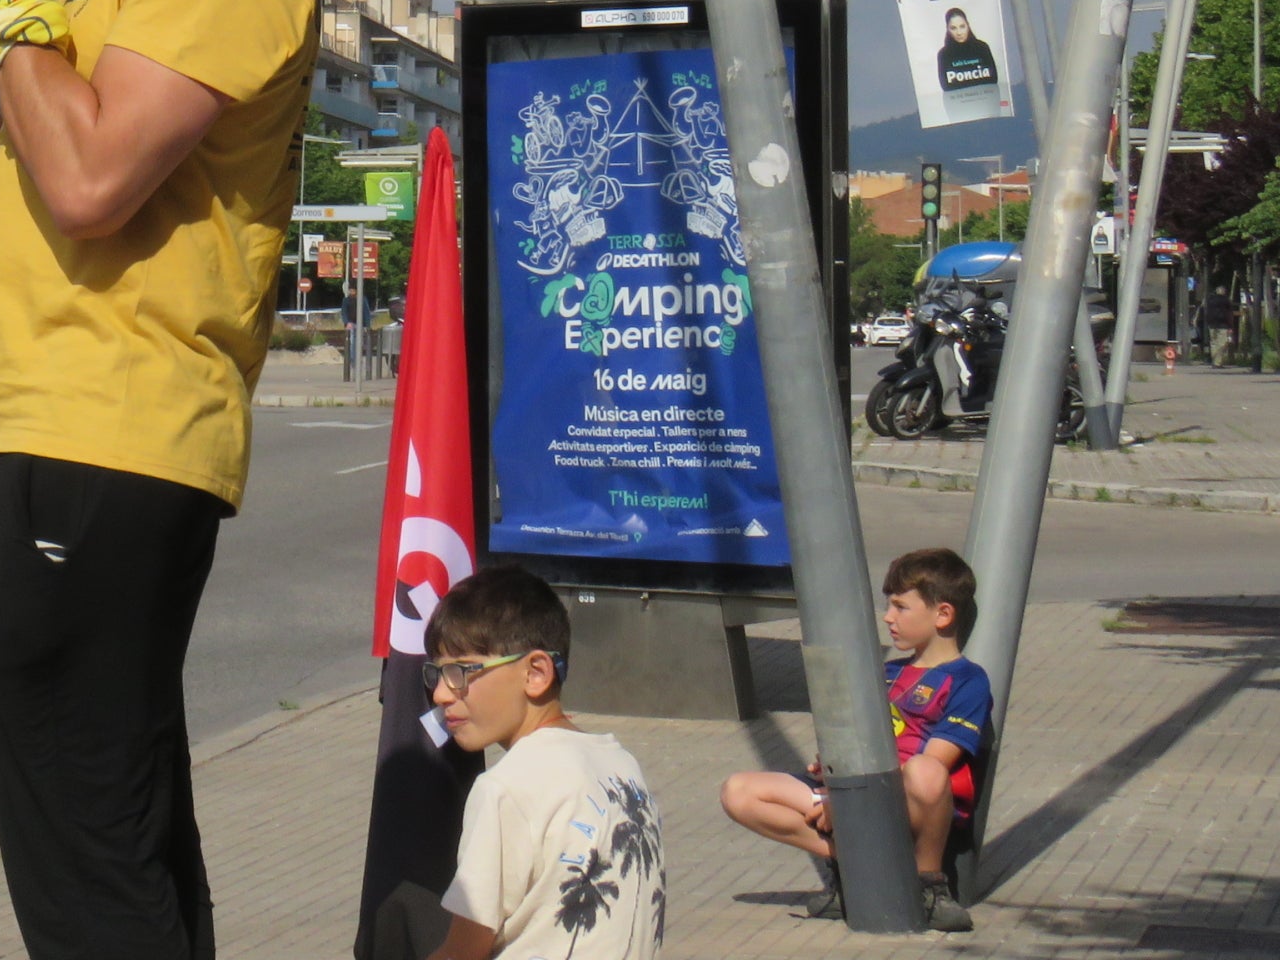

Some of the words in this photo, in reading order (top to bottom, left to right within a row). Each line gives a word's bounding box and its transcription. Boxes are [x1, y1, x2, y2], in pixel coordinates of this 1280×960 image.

[596, 12, 637, 23] ALPHA
[946, 65, 991, 83] Poncia
[292, 207, 323, 217] Correos
[612, 251, 700, 268] DECATHLON
[558, 272, 745, 326] Camping
[564, 320, 737, 356] Experience
[593, 368, 614, 391] 16
[617, 368, 647, 390] de
[584, 405, 640, 421] Música
[641, 409, 662, 421] en
[663, 405, 725, 422] directe
[567, 425, 612, 437] Convidat
[612, 426, 656, 439] especial
[661, 425, 697, 437] Tallers
[698, 428, 717, 438] per
[718, 428, 726, 437] a
[727, 428, 748, 438] nens
[548, 440, 595, 451] Activitats
[595, 442, 649, 454] esportives
[653, 441, 708, 453] Exposició
[708, 442, 723, 452] de
[554, 454, 579, 466] Food
[579, 457, 605, 468] truck
[609, 456, 637, 468] Zona
[637, 456, 661, 468] chill
[608, 489, 638, 506] T'hi
